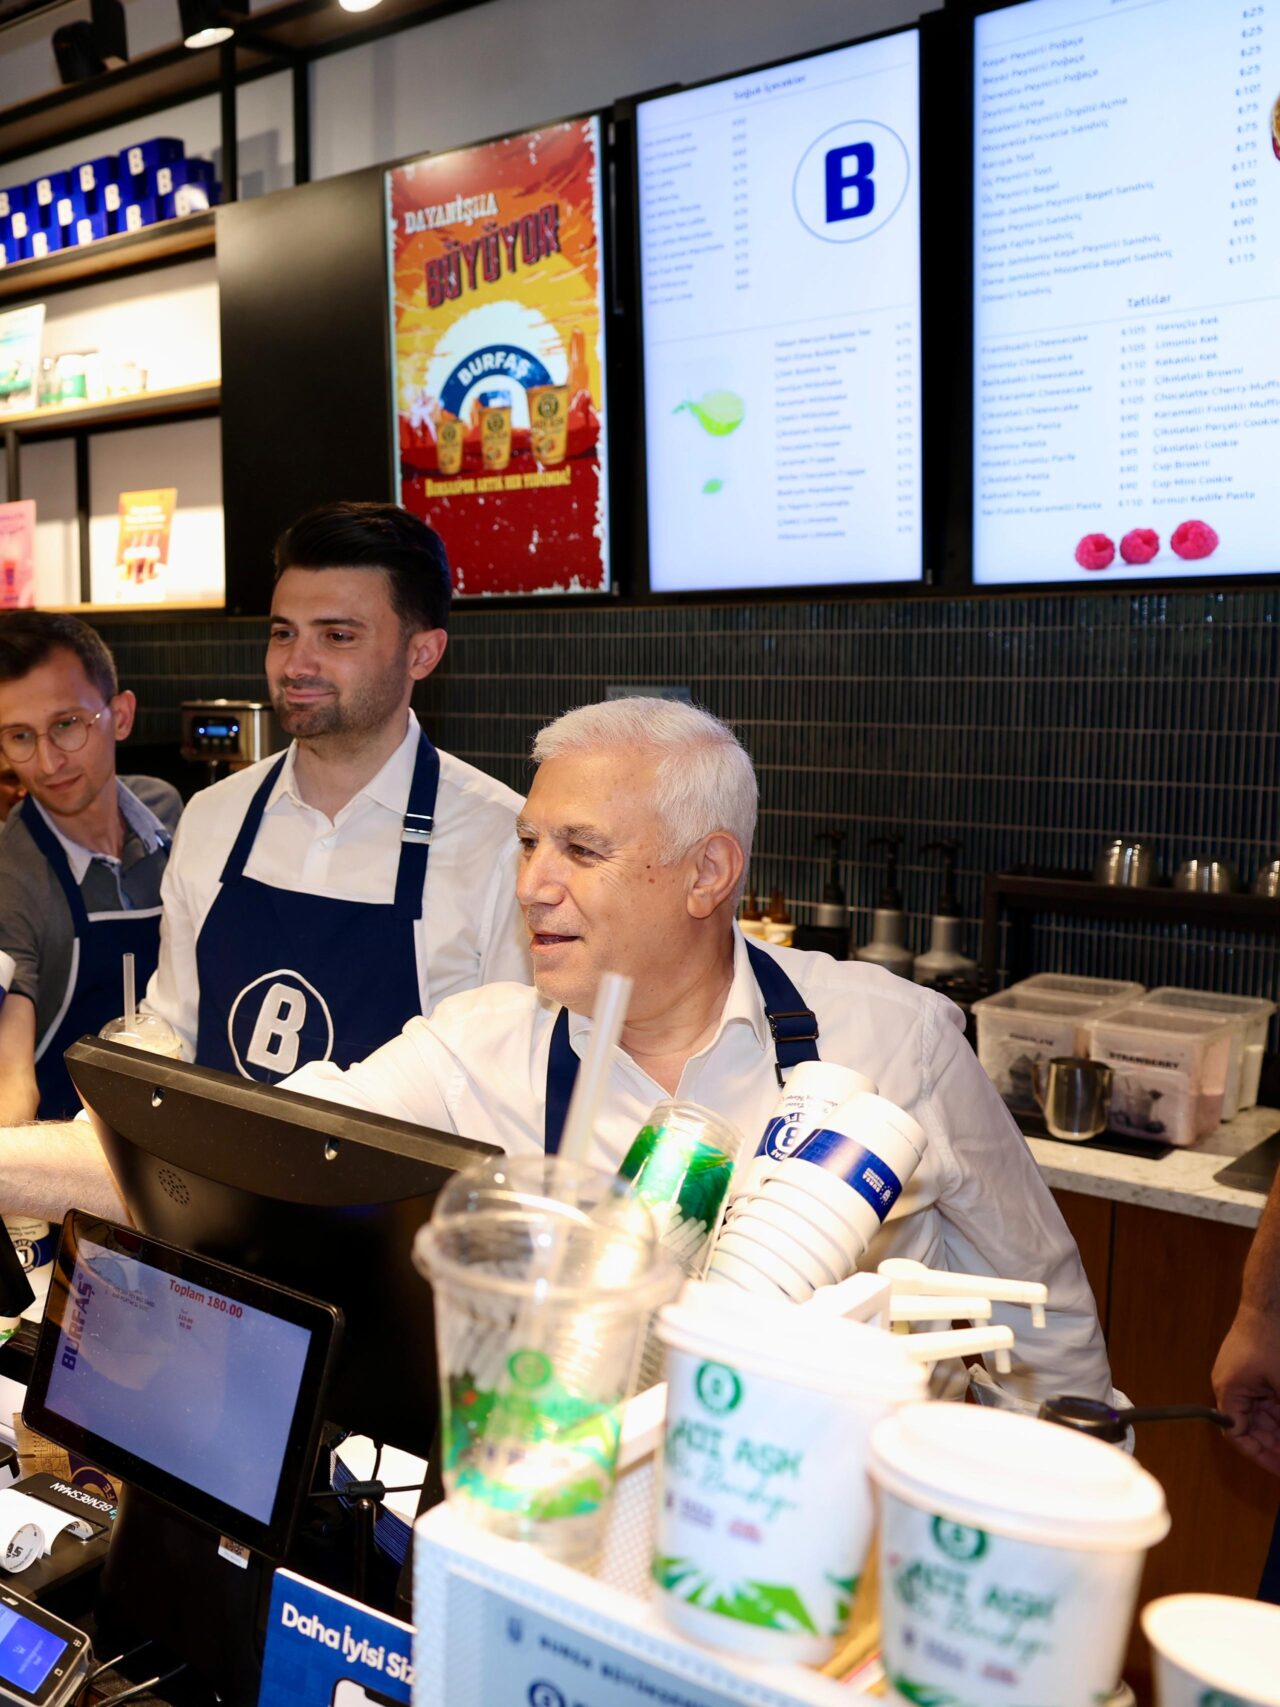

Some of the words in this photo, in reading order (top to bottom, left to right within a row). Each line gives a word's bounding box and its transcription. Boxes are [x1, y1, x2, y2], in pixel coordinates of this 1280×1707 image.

[825, 141, 875, 224] B
[425, 203, 561, 309] BÜYÜYOR
[457, 351, 532, 387] BURFAŞ
[247, 983, 307, 1074] B
[1109, 1051, 1179, 1070] STRAWBERRY
[61, 1282, 95, 1372] BURFAŞ
[169, 1279, 206, 1305] Toplam
[207, 1295, 244, 1319] 180.00
[49, 1482, 114, 1512] GENRESMAN
[281, 1602, 341, 1650] Daha
[342, 1624, 385, 1671] İyisi
